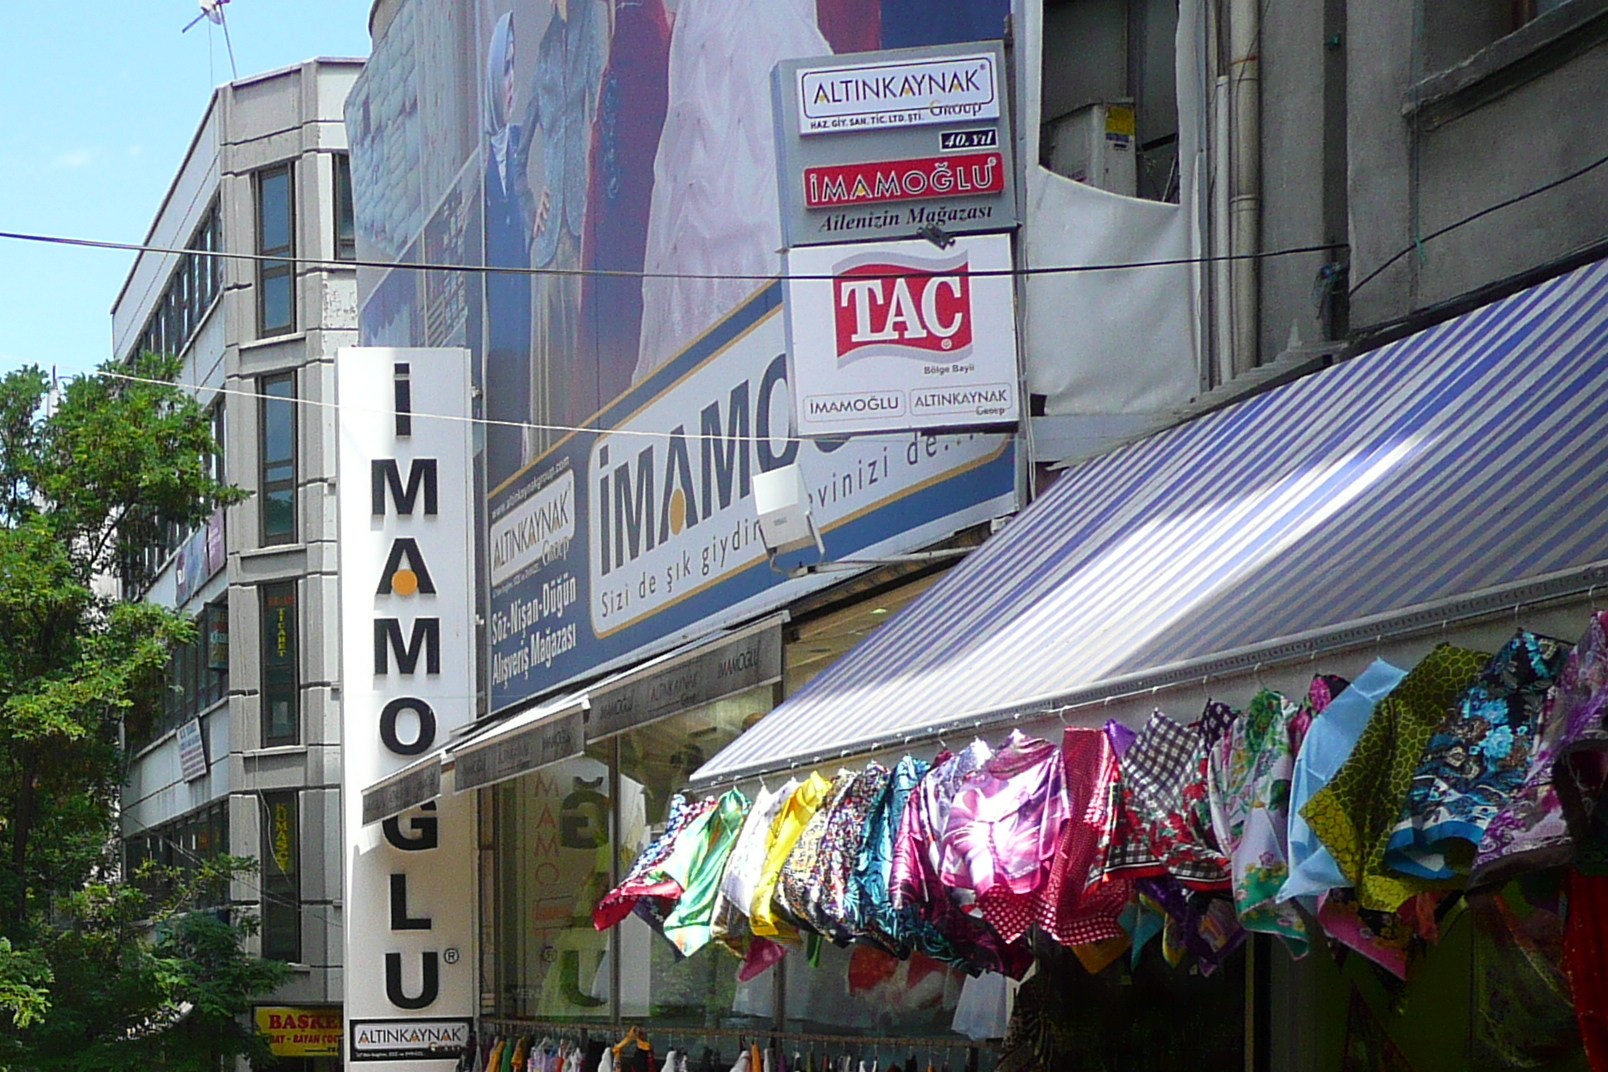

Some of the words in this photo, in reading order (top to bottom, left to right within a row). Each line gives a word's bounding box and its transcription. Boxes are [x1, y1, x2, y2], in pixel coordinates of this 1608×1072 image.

[813, 68, 981, 105] ALTINKAYNAK
[810, 161, 994, 203] İMAMOĞLU
[819, 209, 900, 233] Ailenizin
[906, 204, 992, 228] Mağazası
[810, 394, 899, 415] İMAMOĞLU
[915, 389, 1007, 408] ALTINKAYNAK
[493, 489, 569, 572] ALTINKAYNAK
[600, 589, 630, 619] Sizi
[638, 568, 657, 600] de
[666, 557, 691, 593] şık
[492, 640, 530, 690] Alışveriş
[530, 622, 577, 669] Mağazası
[269, 1013, 343, 1032] BAŞKE
[357, 1027, 463, 1044] ALTINKAYNAK
